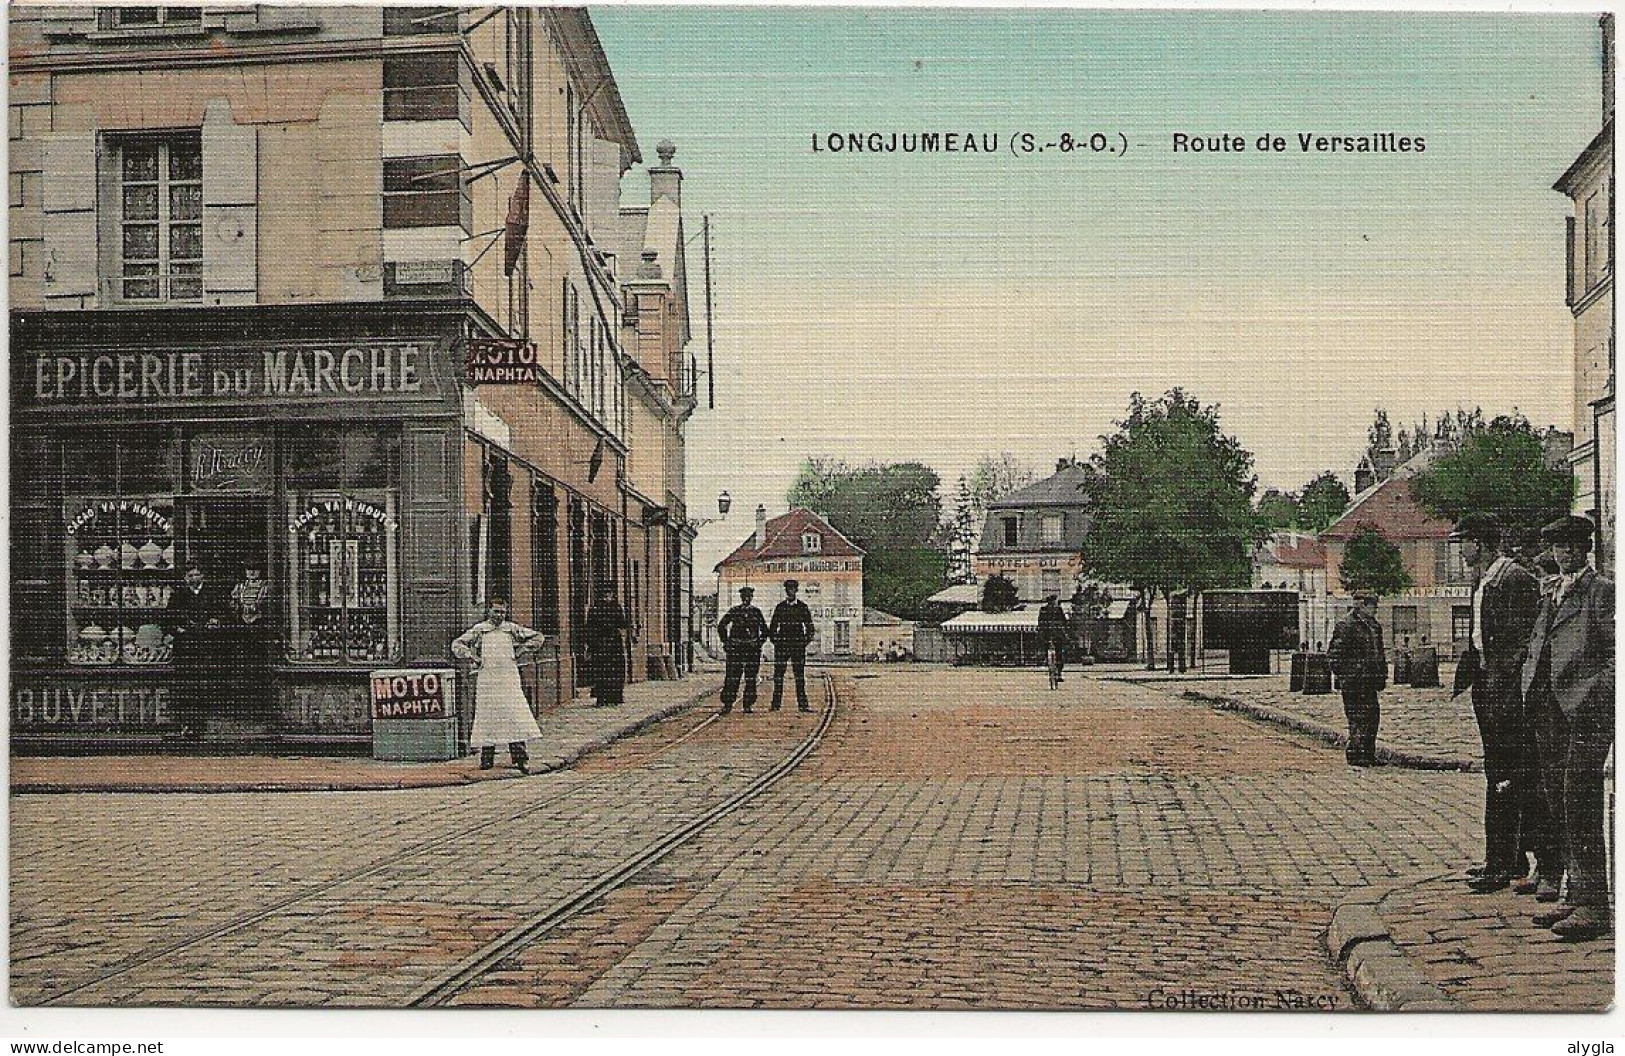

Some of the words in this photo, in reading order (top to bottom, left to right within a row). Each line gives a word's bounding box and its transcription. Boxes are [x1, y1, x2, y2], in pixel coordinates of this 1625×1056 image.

[212, 369, 252, 395] DU
[67, 508, 95, 534] CACAO
[101, 500, 127, 513] VAN
[289, 507, 319, 533] CACAO
[324, 498, 353, 512] VAN
[375, 674, 439, 700] MOTO
[17, 688, 170, 723] BUVETTE
[294, 687, 369, 723] TAB
